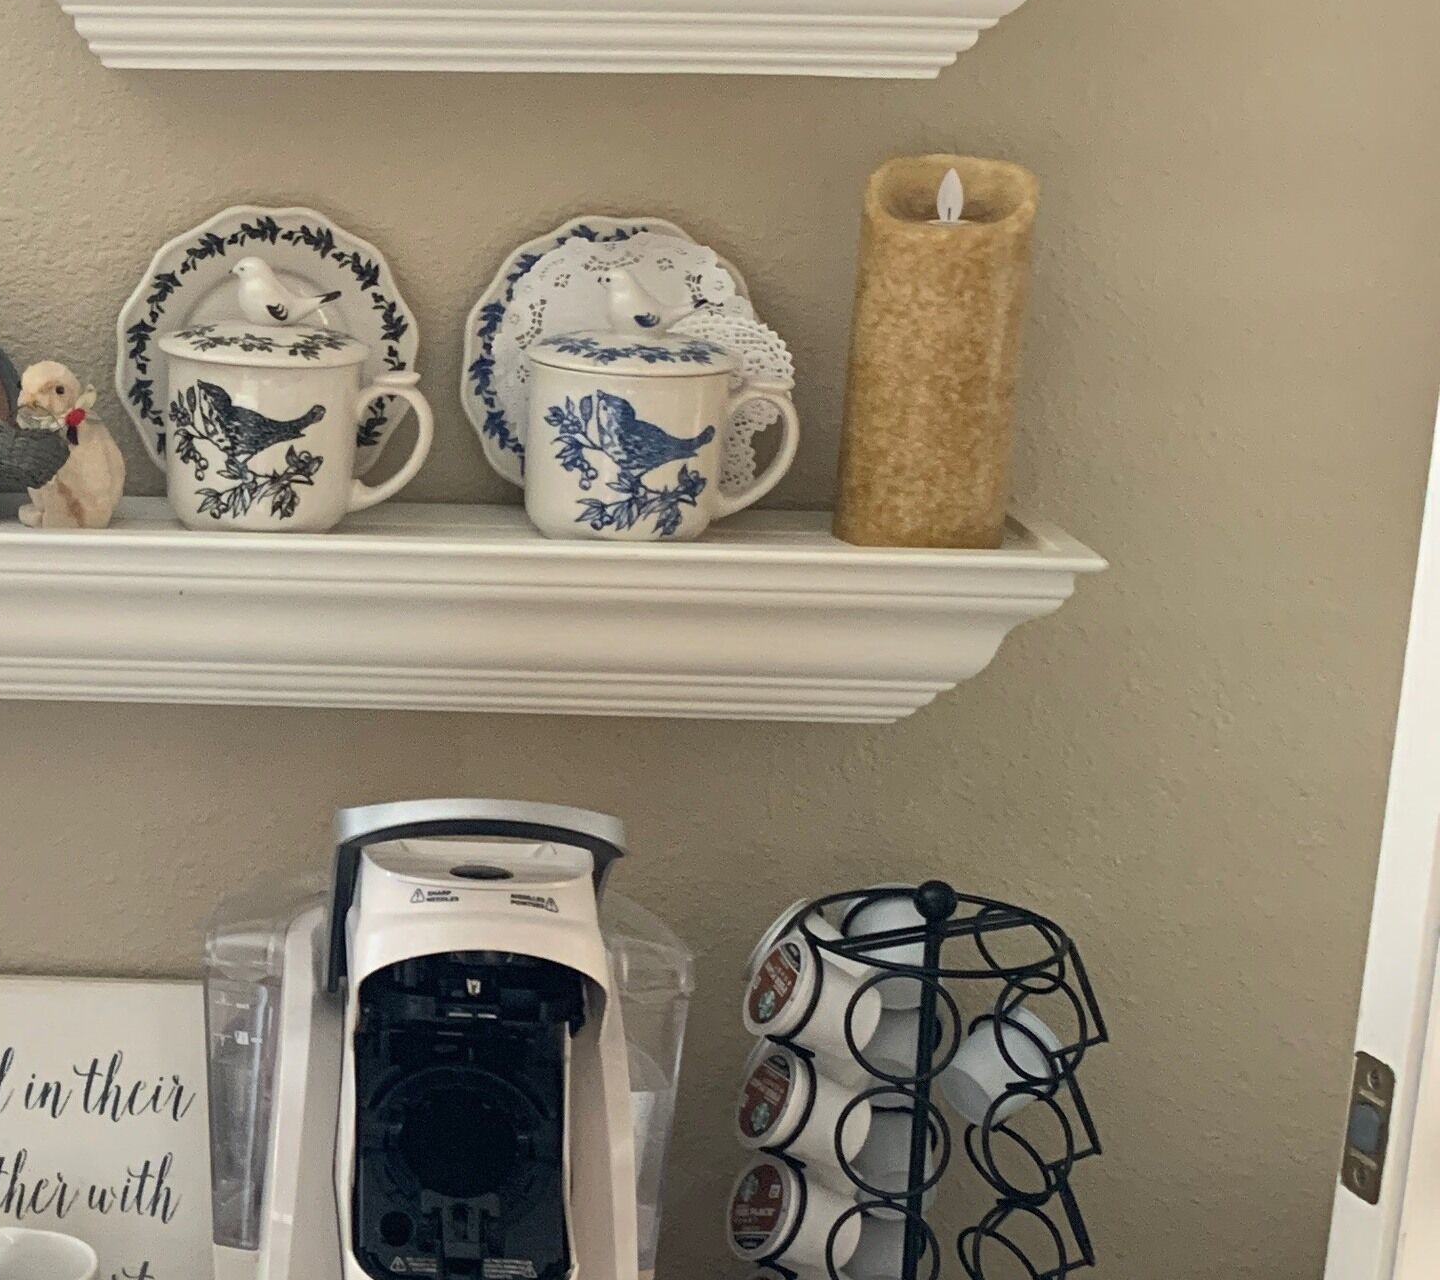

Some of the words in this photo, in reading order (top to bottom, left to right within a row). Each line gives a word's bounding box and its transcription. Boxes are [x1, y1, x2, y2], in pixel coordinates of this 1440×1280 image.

[24, 1072, 73, 1119] in
[73, 1049, 197, 1122] their
[87, 1151, 182, 1224] with
